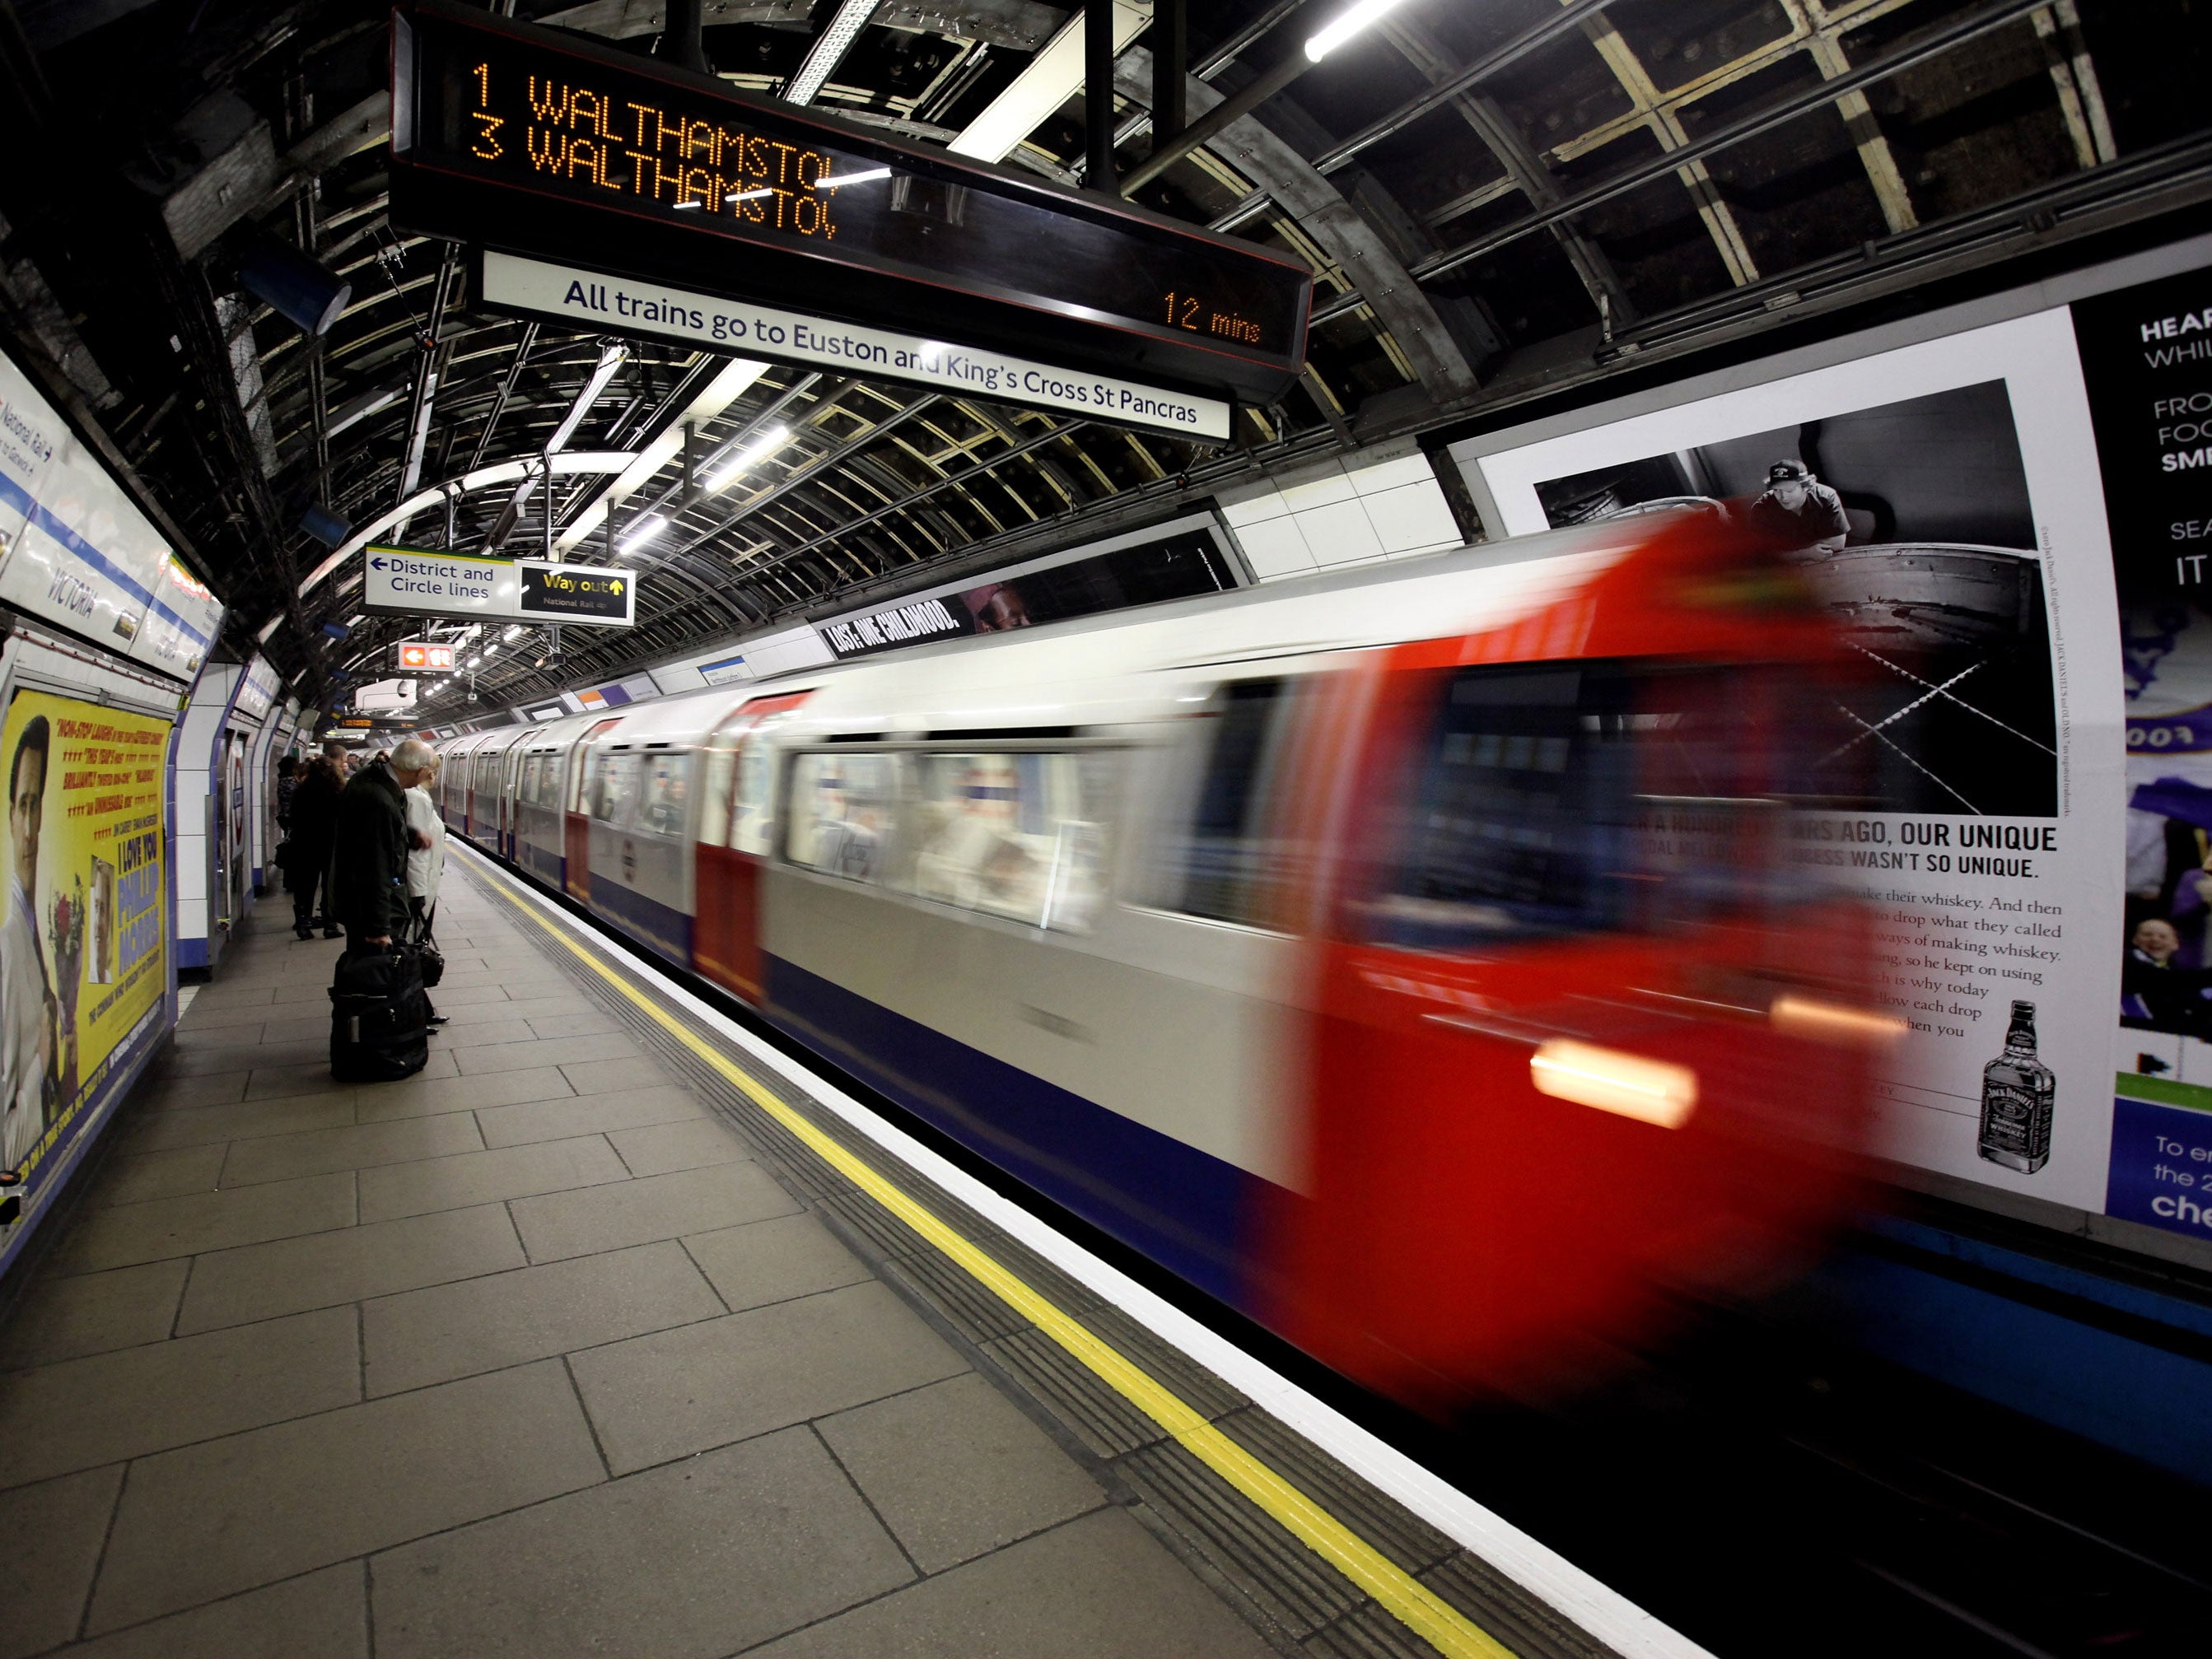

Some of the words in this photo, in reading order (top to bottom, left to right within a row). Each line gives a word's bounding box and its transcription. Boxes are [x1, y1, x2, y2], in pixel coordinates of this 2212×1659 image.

[473, 63, 488, 106] 1
[472, 112, 503, 159] 3
[1164, 292, 1197, 329] 12
[1211, 313, 1261, 343] mins
[563, 280, 609, 313] All
[615, 291, 703, 329] trains
[711, 314, 748, 340] go
[755, 318, 786, 344] to
[793, 324, 888, 364] Euston
[894, 348, 940, 375] and
[946, 353, 1018, 390] King’s
[1023, 371, 1087, 403] Cross
[1094, 384, 1114, 408] St
[1120, 389, 1197, 423] Pancras
[1, 402, 34, 445] National
[30, 433, 47, 457] Rail
[391, 558, 457, 578] District
[464, 569, 493, 581] and
[2176, 554, 2208, 586] IT
[391, 577, 442, 595] Circle
[450, 583, 488, 599] lines
[544, 574, 577, 594] Way
[581, 580, 609, 594] out
[544, 597, 577, 608] National
[580, 600, 595, 609] Rail
[825, 623, 865, 653] LOST:
[853, 617, 887, 646] ONE
[875, 599, 960, 641] CHILDHOOD.
[1841, 820, 1892, 846] AGO,
[1901, 822, 1949, 846] OUR
[1960, 824, 2057, 851] UNIQUE
[124, 836, 142, 873] LOVE
[143, 832, 157, 863] YOU
[1850, 850, 1919, 871] WASN’T
[1926, 855, 1950, 873] SO
[1958, 856, 2038, 878] UNIQUE.
[117, 861, 160, 928] PHILLIP
[1886, 890, 1916, 903] their
[1921, 892, 1984, 910] whiskey.
[1989, 897, 2022, 912] And
[2028, 902, 2062, 916] then
[1893, 911, 1925, 928] drop
[1931, 916, 1967, 930] what
[1974, 920, 2009, 935] they
[2014, 925, 2061, 938] called
[119, 906, 160, 976] MORRIS
[1876, 933, 1911, 946] ways
[1914, 934, 1930, 946] of
[1931, 937, 1987, 956] making
[1993, 944, 2061, 962] whiskey.
[1906, 958, 1920, 967] so
[1925, 955, 1940, 968] he
[1944, 958, 1975, 976] kept
[1978, 967, 1997, 976] on
[2001, 968, 2042, 986] using
[1895, 976, 1906, 986] is
[1911, 977, 1942, 994] why
[1948, 984, 1989, 1000] today
[1914, 1000, 1944, 1013] each
[1948, 1005, 1982, 1021] drop
[1937, 1025, 1965, 1038] you
[2155, 1135, 2184, 1157] To
[2154, 1163, 2195, 1186] the
